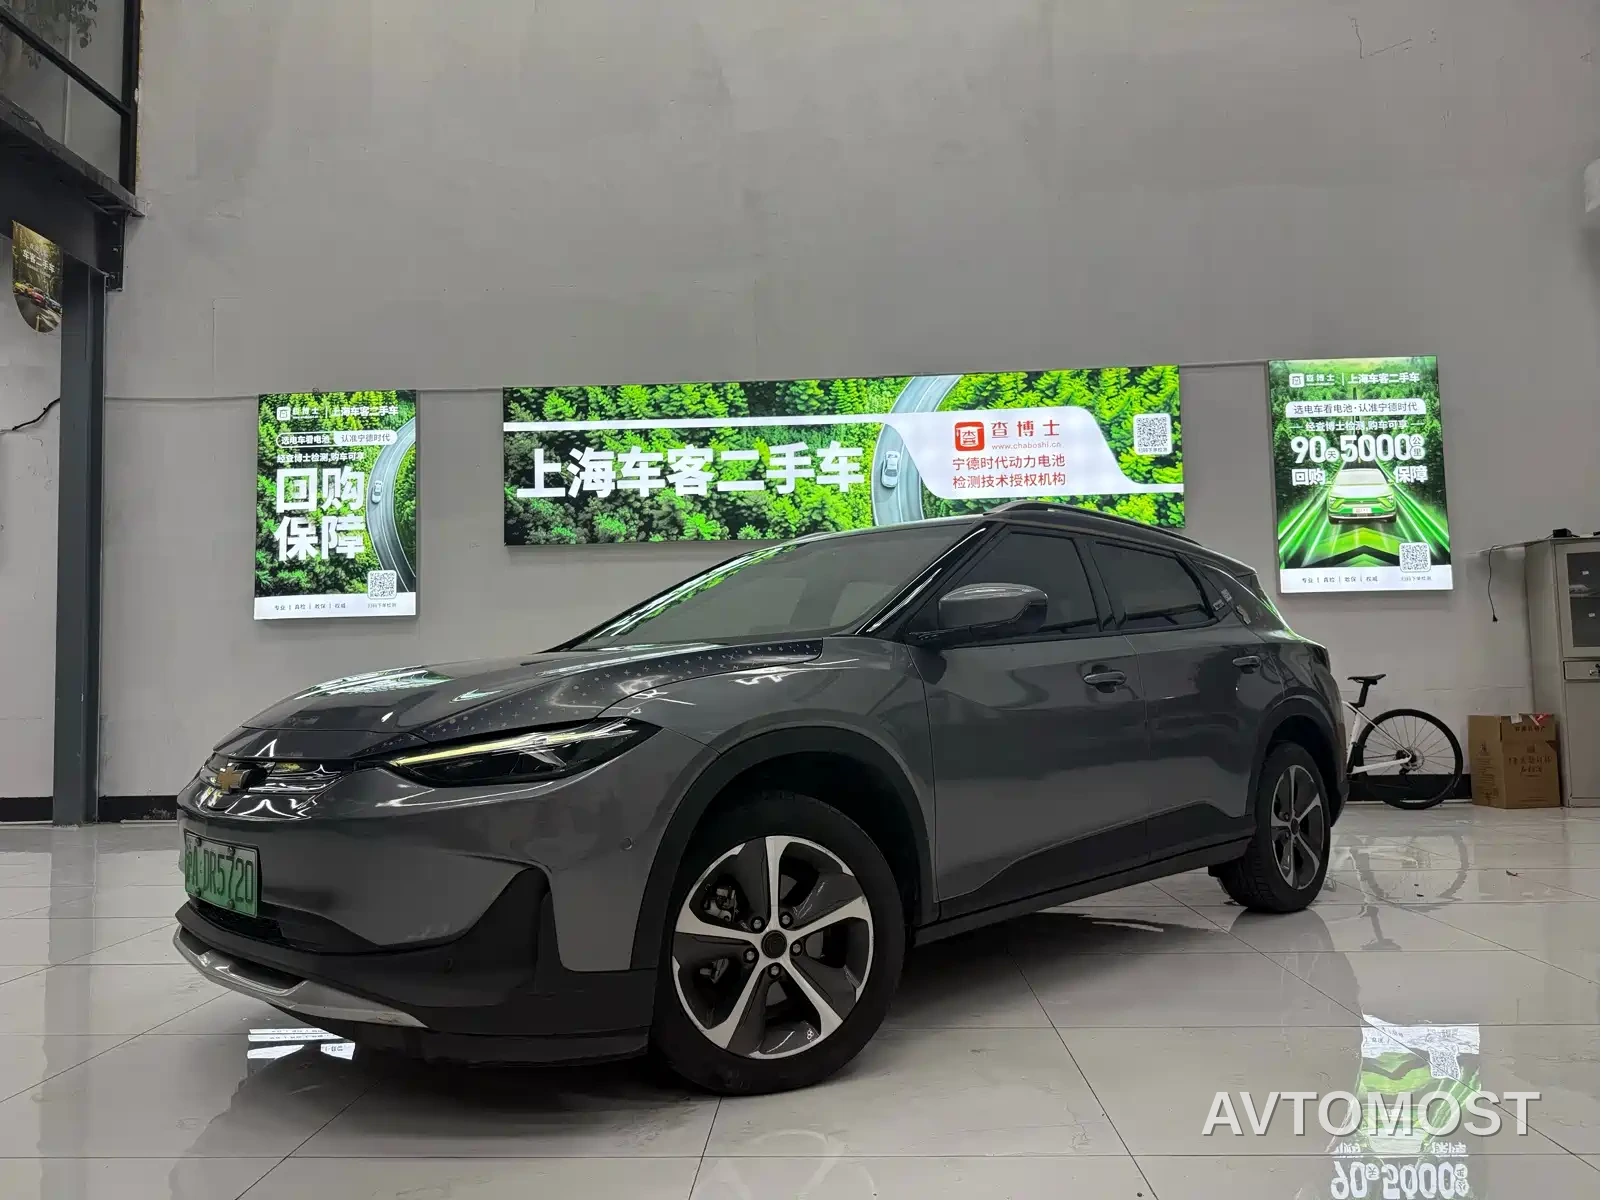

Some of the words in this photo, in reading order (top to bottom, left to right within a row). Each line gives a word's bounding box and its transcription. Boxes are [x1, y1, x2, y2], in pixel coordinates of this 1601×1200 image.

[1348, 372, 1420, 384] 上海车客二手车
[333, 405, 399, 417] 上海车客二手车
[1293, 402, 1417, 414] 选电车看电池·认准宁德时代
[991, 419, 1060, 438] 查博士
[281, 434, 330, 445] 选电车看电池
[341, 433, 391, 443] 认准宁德时代
[992, 441, 1062, 450] www.chaboshi.cn
[516, 441, 865, 498] 上海车客二手车
[952, 453, 1066, 471] 宁德时代动力电池
[952, 472, 1066, 489] 检测技术授权机构
[1292, 468, 1326, 486] 回购
[1393, 465, 1429, 483] 保障
[276, 465, 365, 513] 回购
[273, 514, 366, 562] 保障
